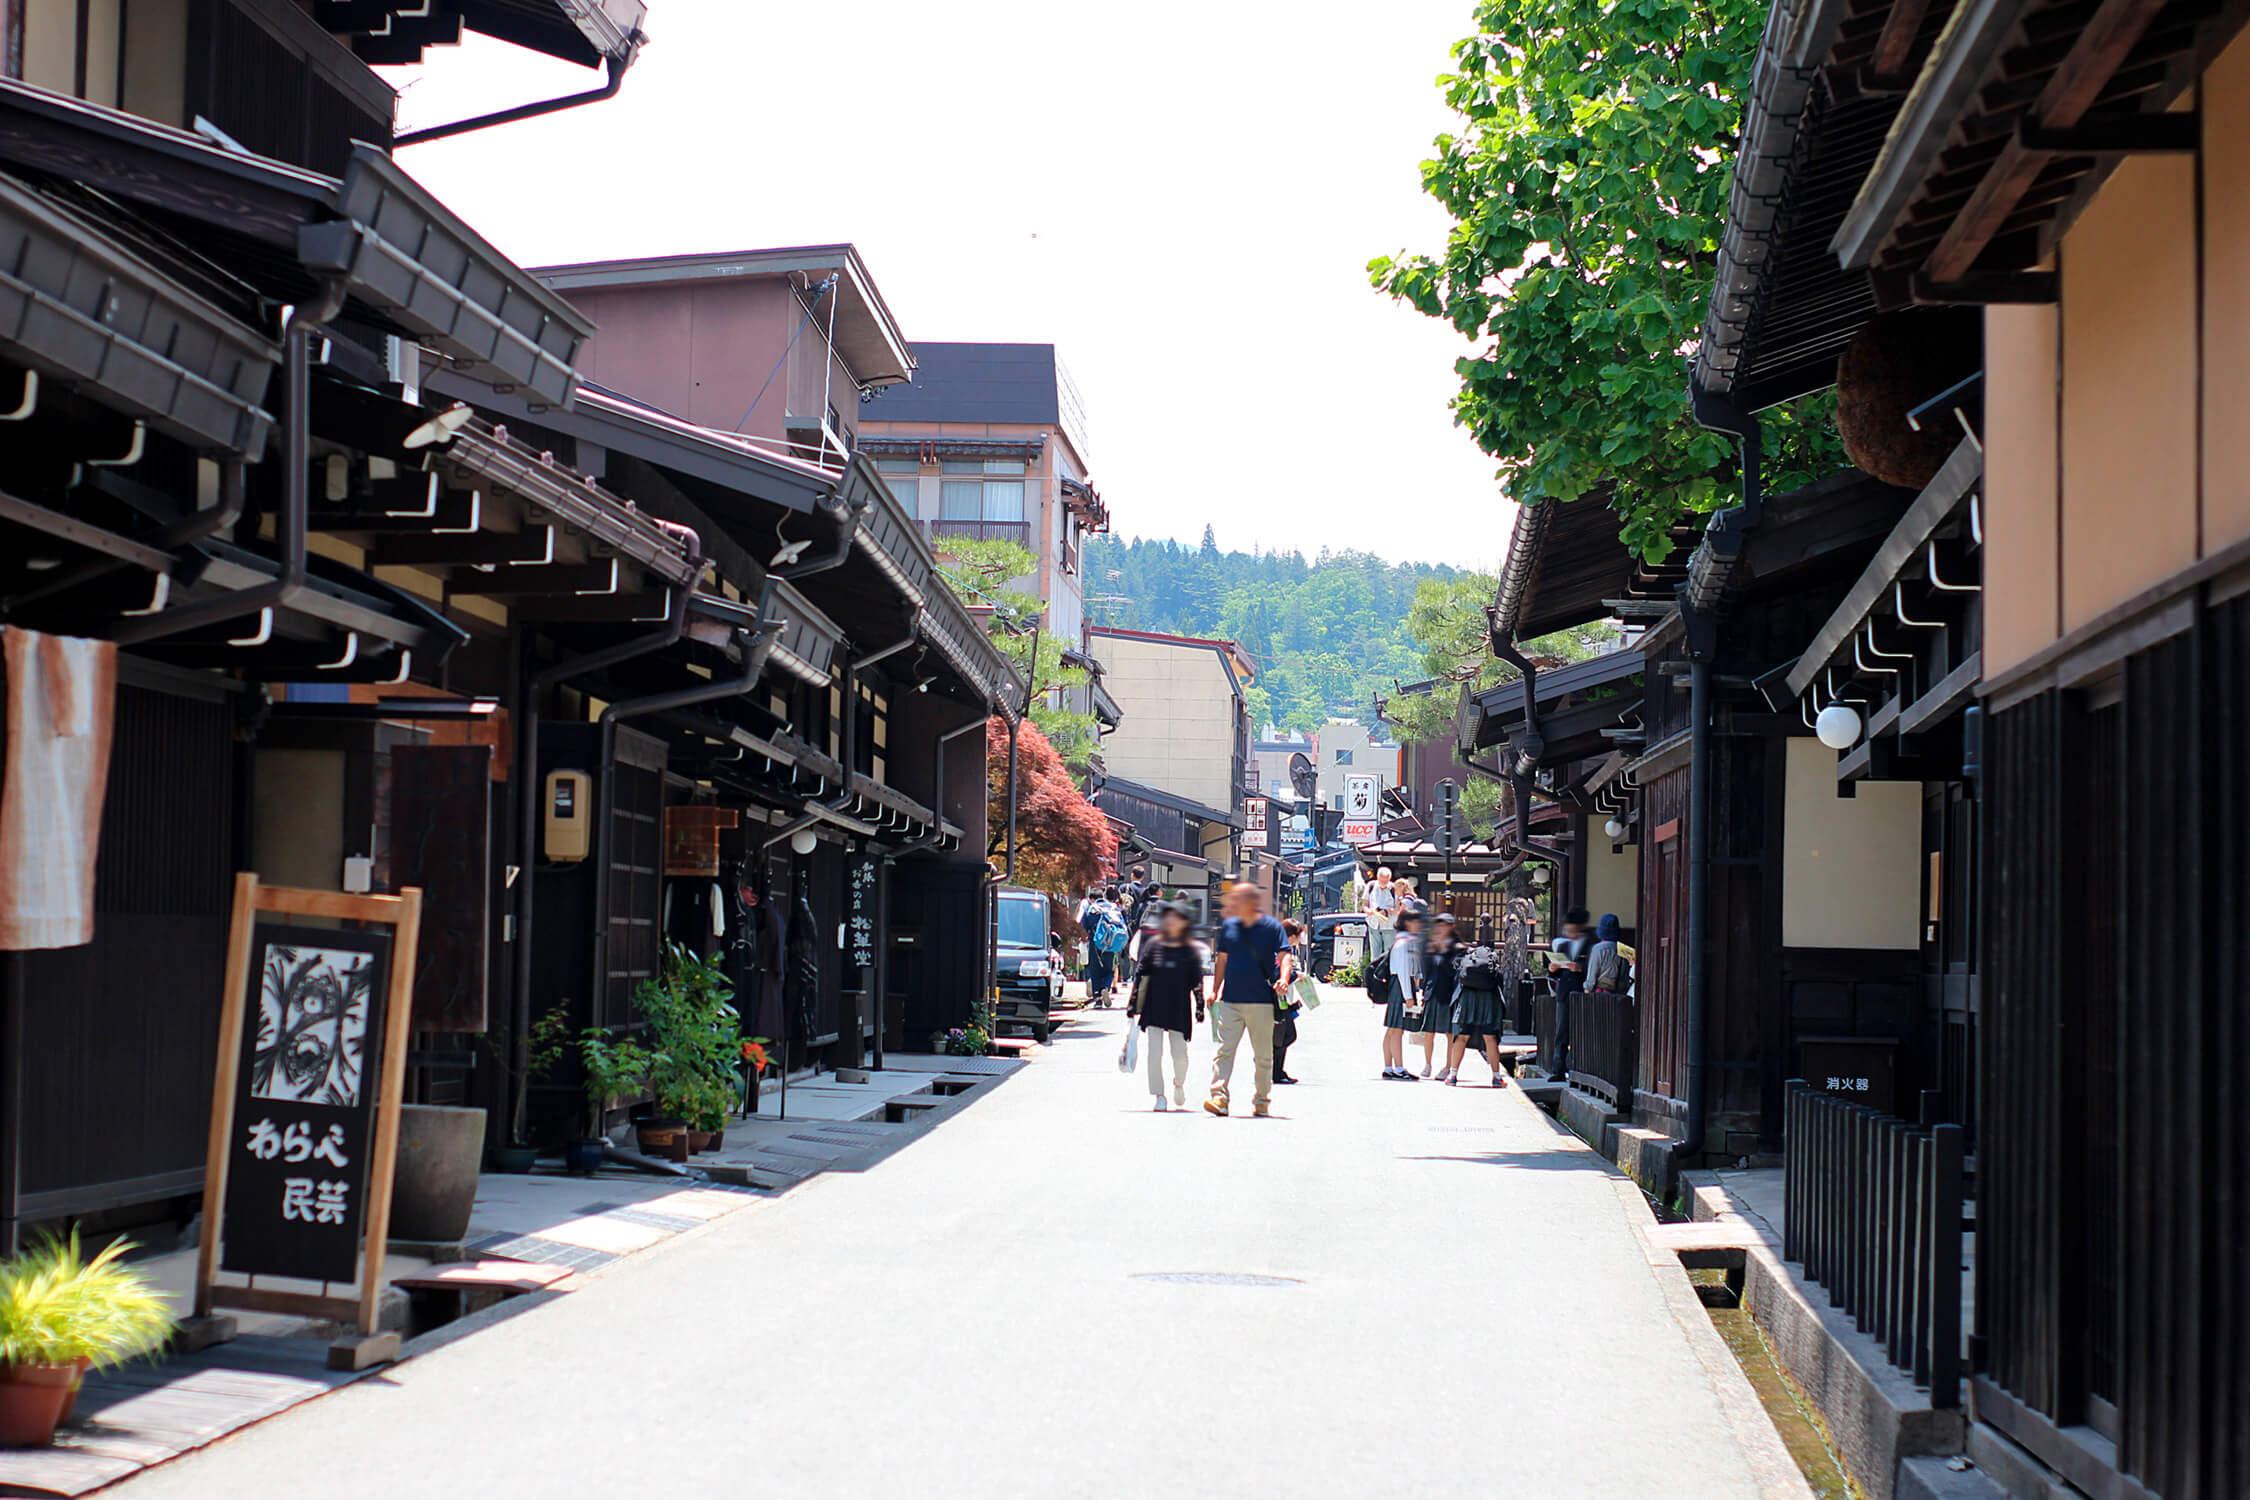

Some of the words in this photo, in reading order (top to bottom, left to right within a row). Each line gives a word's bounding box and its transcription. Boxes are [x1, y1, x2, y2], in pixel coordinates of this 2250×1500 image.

[1826, 1076, 1869, 1091] 消火器
[246, 1117, 349, 1168] わらべ
[282, 1177, 350, 1225] 民芸
